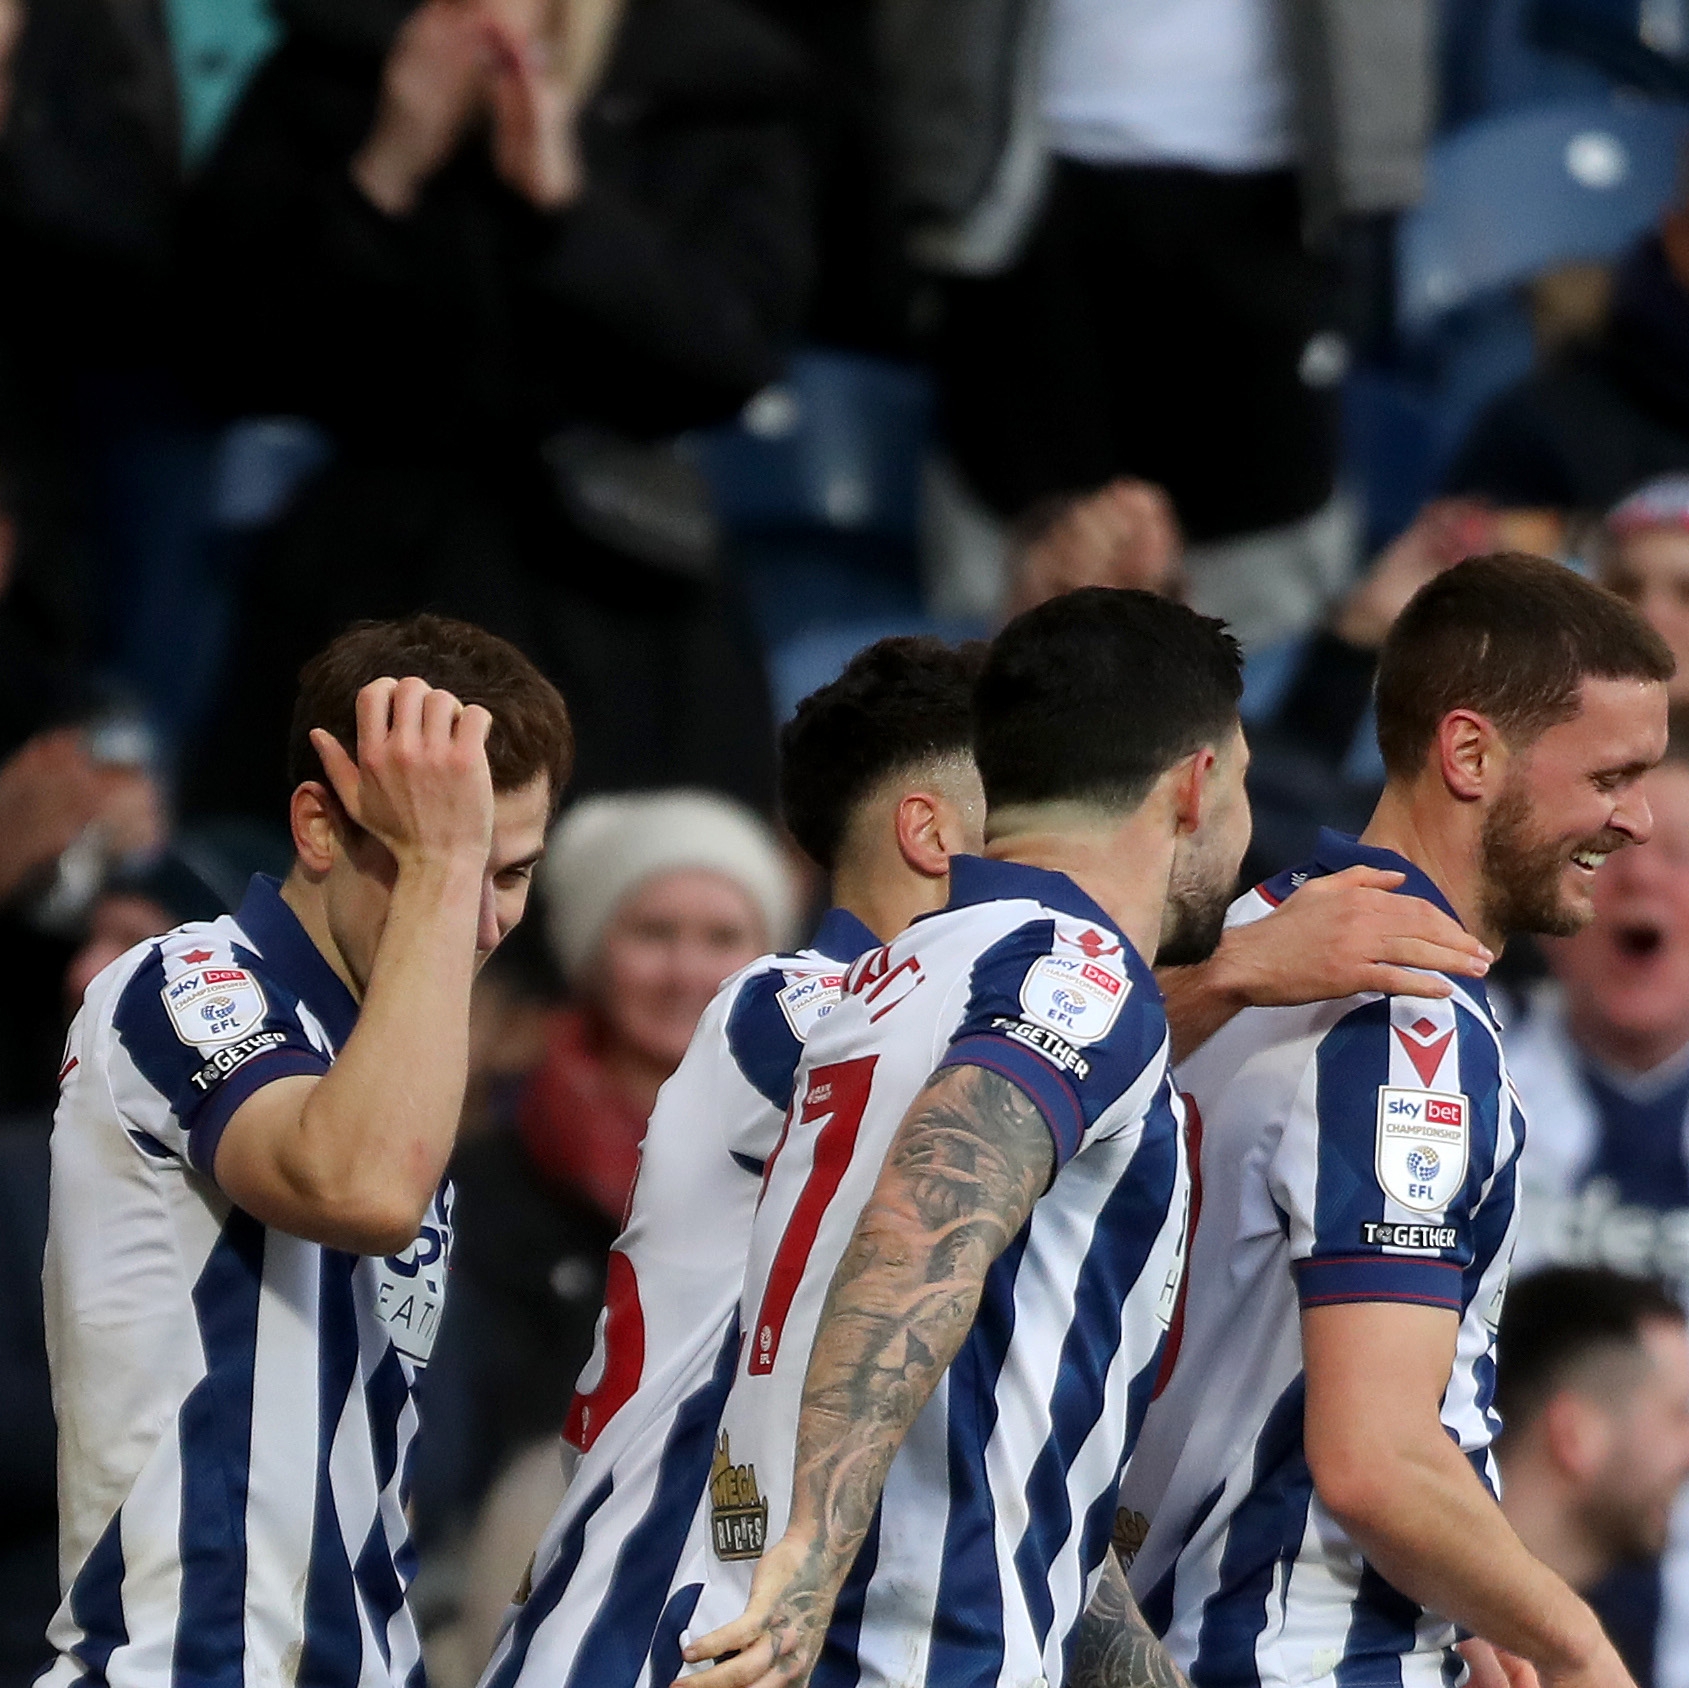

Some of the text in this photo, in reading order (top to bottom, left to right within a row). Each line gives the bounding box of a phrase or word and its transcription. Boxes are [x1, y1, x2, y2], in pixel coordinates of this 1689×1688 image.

[168, 970, 243, 999] sky bet
[1084, 965, 1118, 993] bet
[174, 980, 250, 1011] CHAMPIONSHIP
[786, 981, 817, 1004] sky
[210, 1017, 241, 1035] EFL
[1047, 1008, 1075, 1029] EFL
[990, 1017, 1090, 1081] TOGETHER
[1387, 1098, 1460, 1122] sky bet
[1385, 1122, 1462, 1142] CHAMPIONSHIP
[1408, 1183, 1435, 1201] EFL
[1364, 1222, 1457, 1249] TOGETHER
[716, 1516, 763, 1552] RICHES
